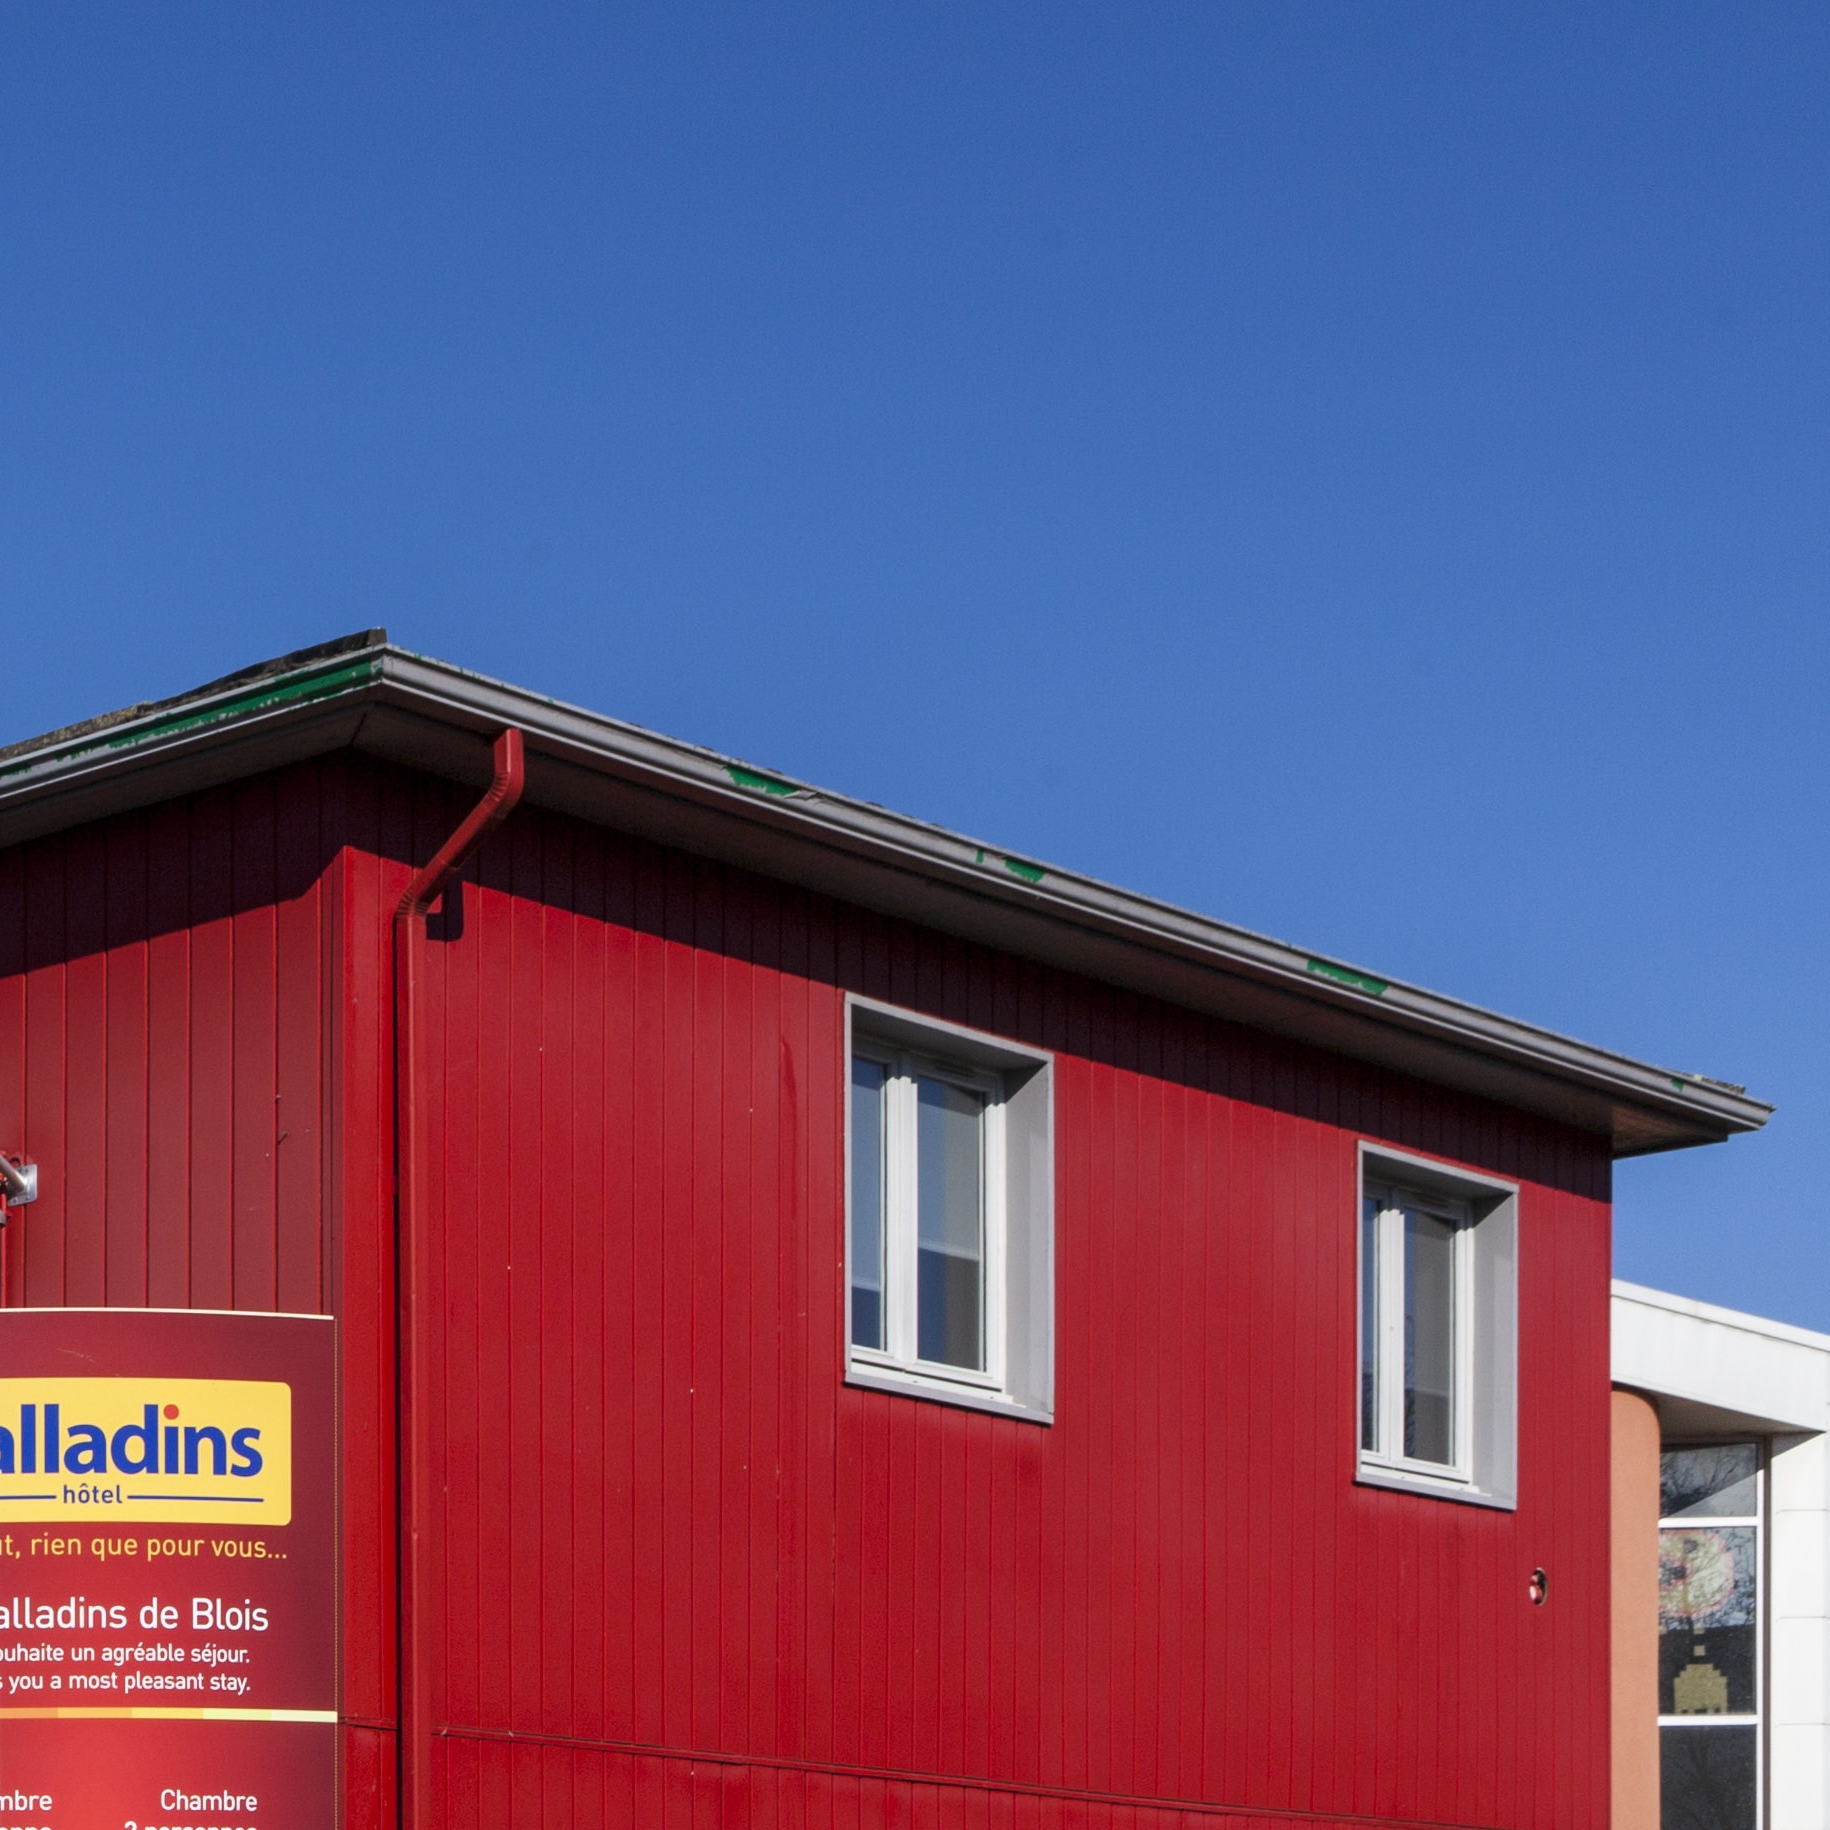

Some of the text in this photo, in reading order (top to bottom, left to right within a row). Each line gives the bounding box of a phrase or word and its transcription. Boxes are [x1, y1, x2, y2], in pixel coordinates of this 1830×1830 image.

[62, 1483, 124, 1506] hôtel
[31, 1533, 82, 1556] rien
[91, 1538, 138, 1562] que
[146, 1538, 204, 1562] pour
[211, 1540, 287, 1560] vous...
[139, 1597, 178, 1630] de
[192, 1599, 269, 1632] Blois
[72, 1646, 96, 1662] un
[101, 1643, 185, 1667] agréable
[191, 1644, 251, 1668] séjour.
[9, 1675, 44, 1695] you
[49, 1676, 62, 1690] a
[69, 1674, 118, 1690] most
[125, 1673, 204, 1693] pleasant
[210, 1675, 251, 1694] stay.
[160, 1789, 258, 1812] Chambre
